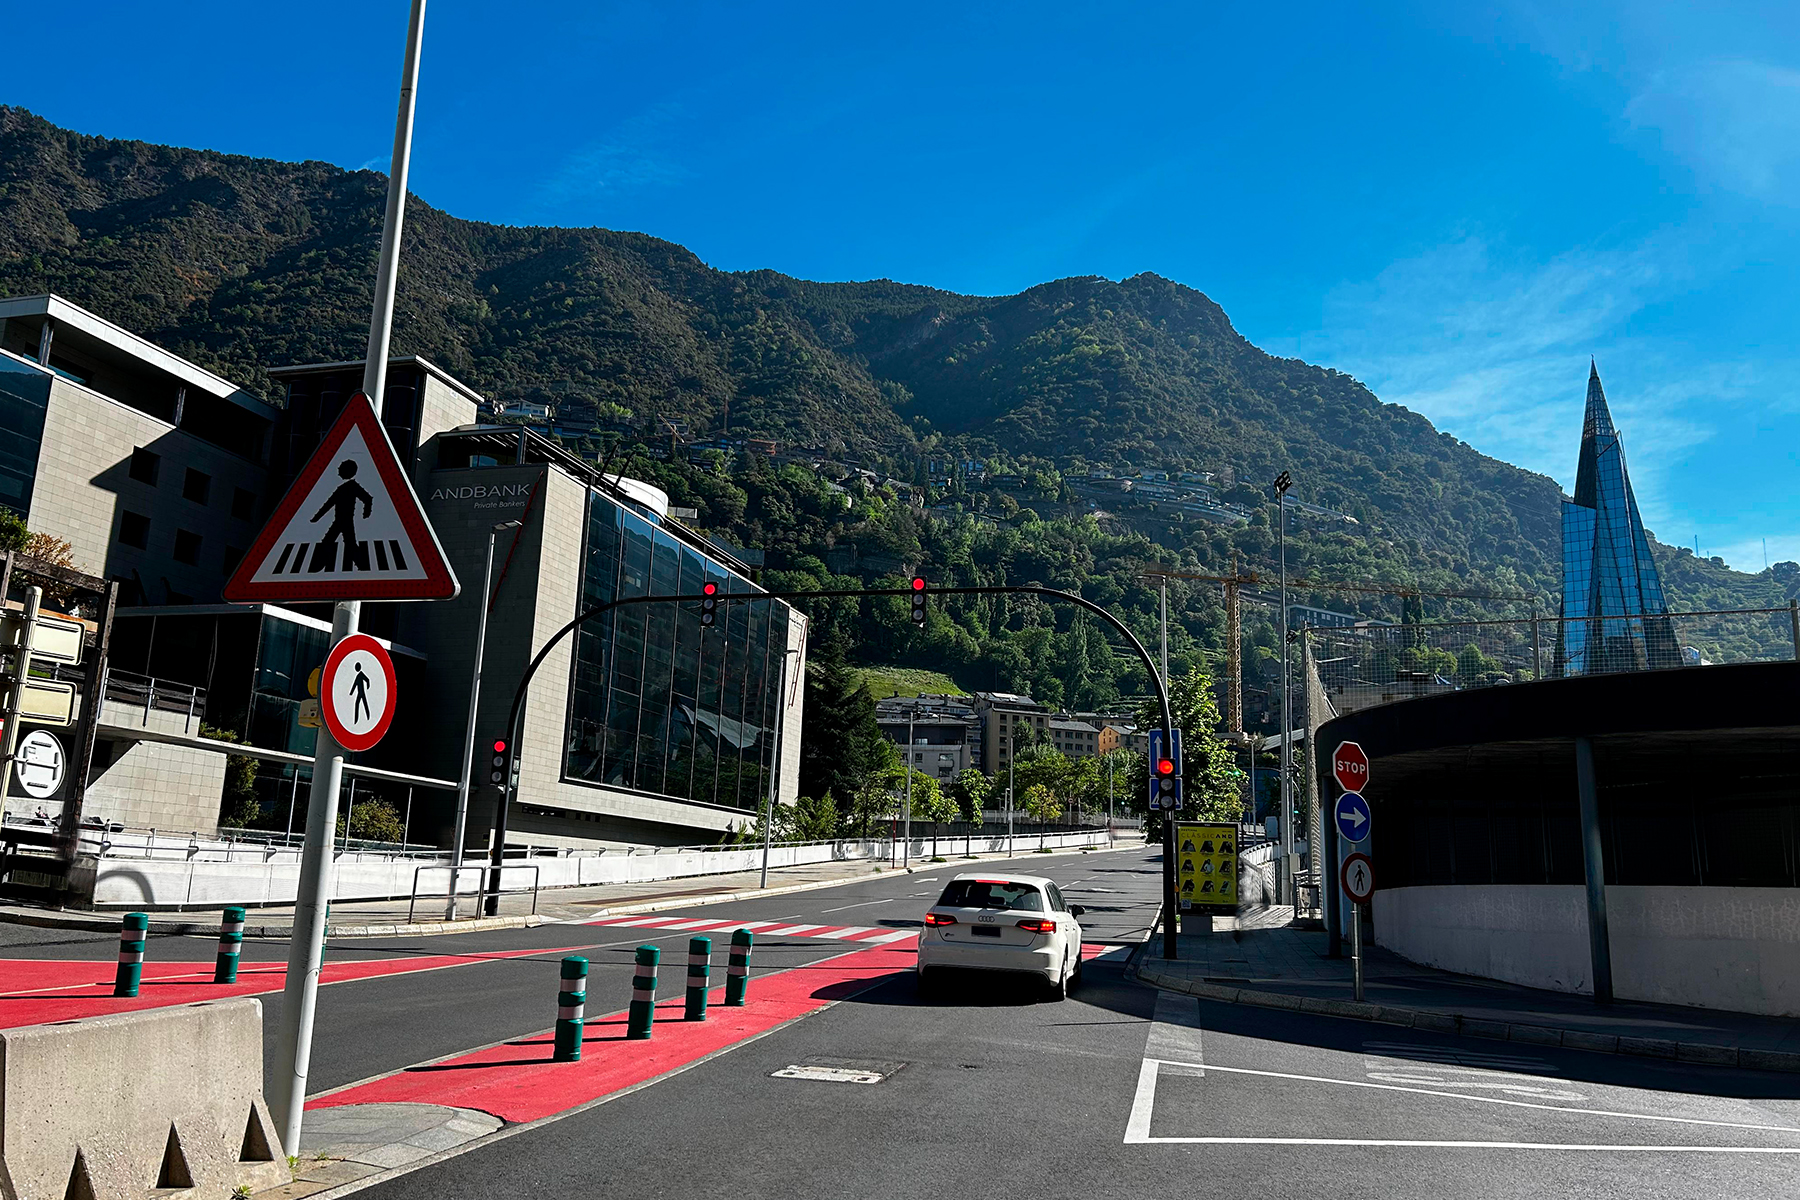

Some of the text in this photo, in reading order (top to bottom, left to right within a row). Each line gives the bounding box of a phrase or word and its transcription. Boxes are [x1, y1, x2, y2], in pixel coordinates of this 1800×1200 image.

[430, 483, 530, 500] ANDBANK
[473, 500, 526, 509] Private Bankers
[1337, 760, 1366, 775] STOP
